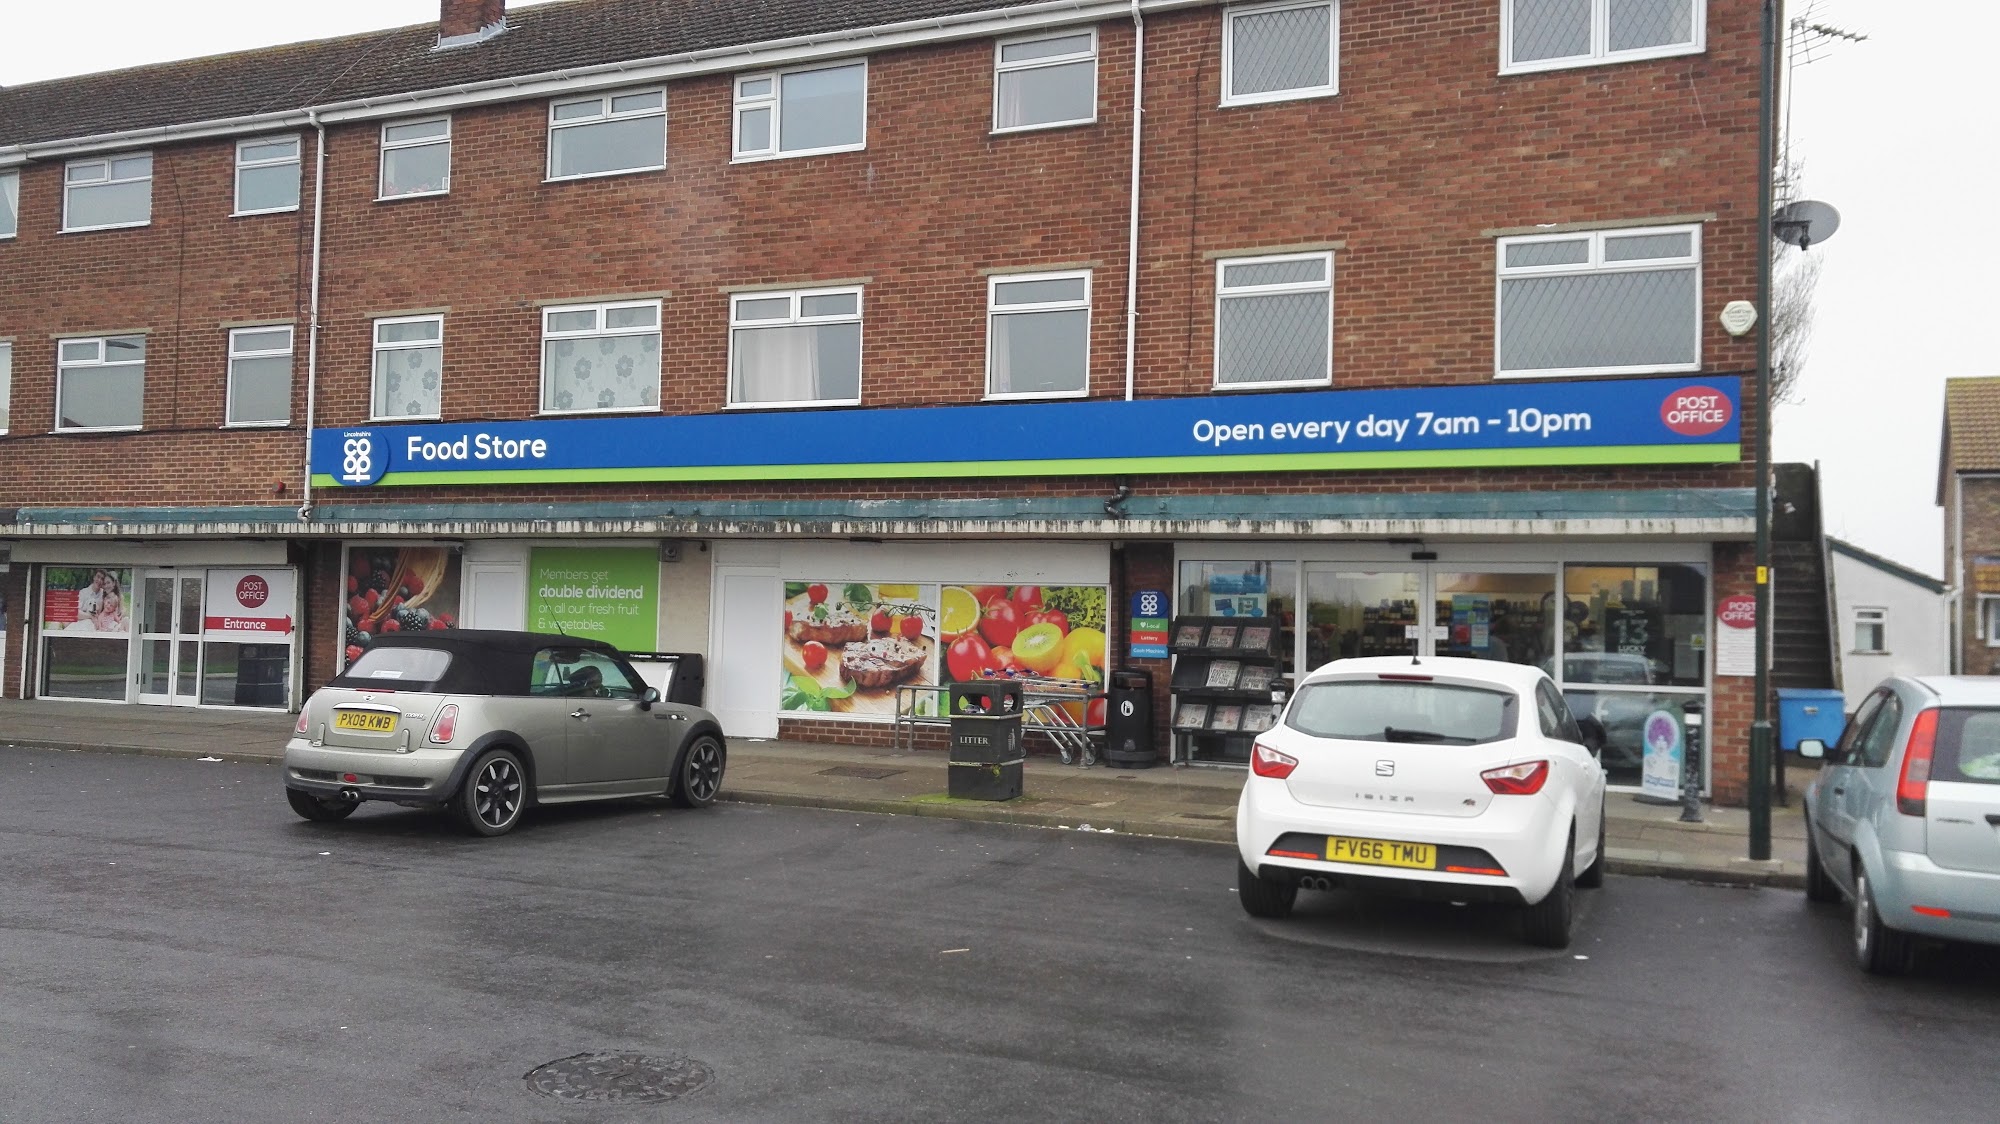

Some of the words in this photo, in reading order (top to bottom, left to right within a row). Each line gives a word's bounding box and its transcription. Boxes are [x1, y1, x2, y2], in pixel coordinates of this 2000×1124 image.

[1677, 396, 1718, 410] POST
[1667, 410, 1724, 424] OFFICE
[1193, 419, 1264, 447] Open
[1270, 420, 1351, 444] every
[1356, 414, 1410, 442] day
[1415, 412, 1480, 436] 7am
[1507, 408, 1591, 438] 10pm
[407, 434, 468, 460] Food
[474, 433, 546, 460] Store
[540, 568, 589, 580] Members
[592, 570, 608, 584] get
[244, 582, 262, 590] POST
[539, 584, 583, 598] double
[586, 584, 644, 599] dividend
[238, 591, 264, 600] OFFICE
[538, 604, 552, 614] on
[554, 602, 566, 614] all
[568, 605, 586, 614] our
[588, 603, 615, 615] fresh
[618, 604, 639, 615] fruit
[1721, 610, 1756, 620] OFFIC
[224, 618, 266, 630] Entrance
[538, 618, 546, 629] &
[548, 618, 606, 634] vegetables.
[340, 714, 366, 727] PX08
[368, 716, 392, 729] KWB
[960, 736, 988, 745] LITTER
[1355, 792, 1414, 802] IBIZA
[1334, 840, 1383, 860] FV66
[1390, 844, 1428, 864] TMU
